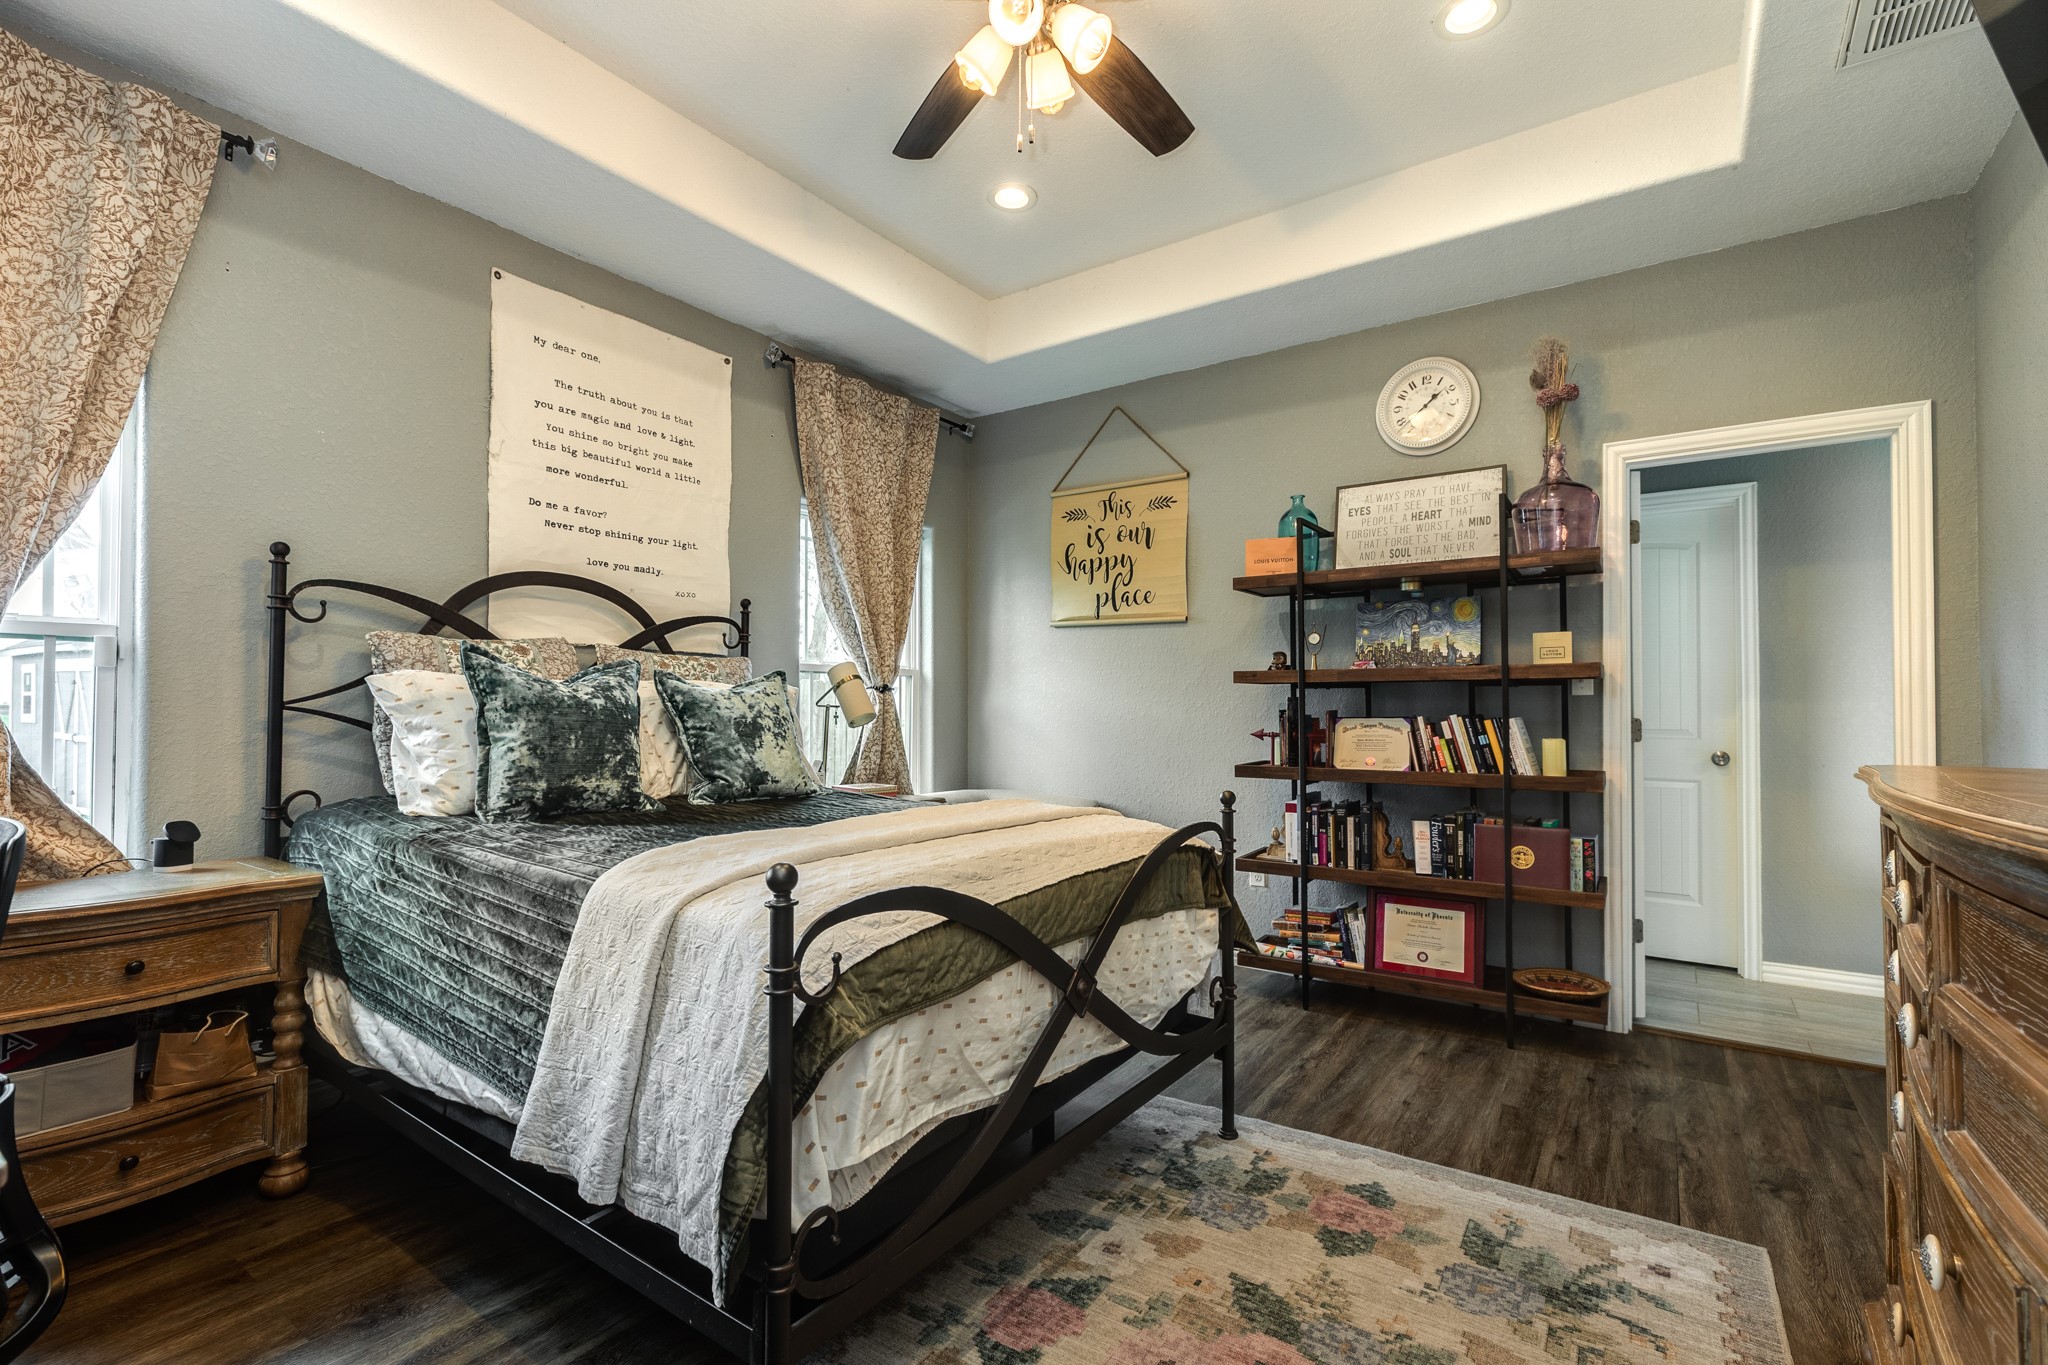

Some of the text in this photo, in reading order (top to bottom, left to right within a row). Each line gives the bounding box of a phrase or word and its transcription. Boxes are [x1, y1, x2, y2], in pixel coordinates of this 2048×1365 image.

[533, 335, 601, 364] My dear one,
[1408, 380, 1418, 391] 11
[1421, 374, 1432, 386] 12
[1436, 376, 1444, 386] 1
[1444, 384, 1456, 395] 2
[554, 379, 693, 428] The truth about you is that
[1397, 390, 1409, 401] 10
[1393, 405, 1404, 414] 9
[534, 399, 696, 448] you are magic and love & light.
[1396, 417, 1407, 427] 8
[546, 423, 693, 468] You shine so bright you make
[532, 438, 556, 451] this
[561, 443, 578, 458] big
[582, 449, 632, 469] beautiful
[635, 464, 662, 477] world
[674, 472, 701, 485] little
[545, 466, 629, 489] more wonderful.
[1364, 482, 1472, 504] ALWAYS PRAY TO HAVE
[528, 497, 608, 519] Do me a favor?
[1097, 491, 1136, 522] This
[1348, 491, 1491, 518] EYES THAT SEE THE BEST IN
[1402, 513, 1407, 522] A
[1411, 509, 1443, 522] HEART
[1449, 505, 1474, 518] THAT
[544, 519, 699, 551] Never stop shining your light.
[1086, 521, 1156, 554] is our
[1346, 526, 1388, 540] FORGIVES
[1393, 524, 1411, 535] THE
[1458, 519, 1464, 528] A
[1468, 515, 1492, 527] MIND
[1358, 539, 1381, 550] THAT
[1385, 534, 1429, 547] FORGETS
[1434, 531, 1452, 543] THE
[1359, 551, 1376, 561] AND
[1380, 550, 1385, 559] A
[1389, 547, 1412, 559] SOUL
[1413, 544, 1438, 556] THAT
[1443, 541, 1475, 553] NEVER
[586, 557, 664, 577] love you madly.
[1057, 543, 1137, 587] happy
[1094, 572, 1156, 619] place
